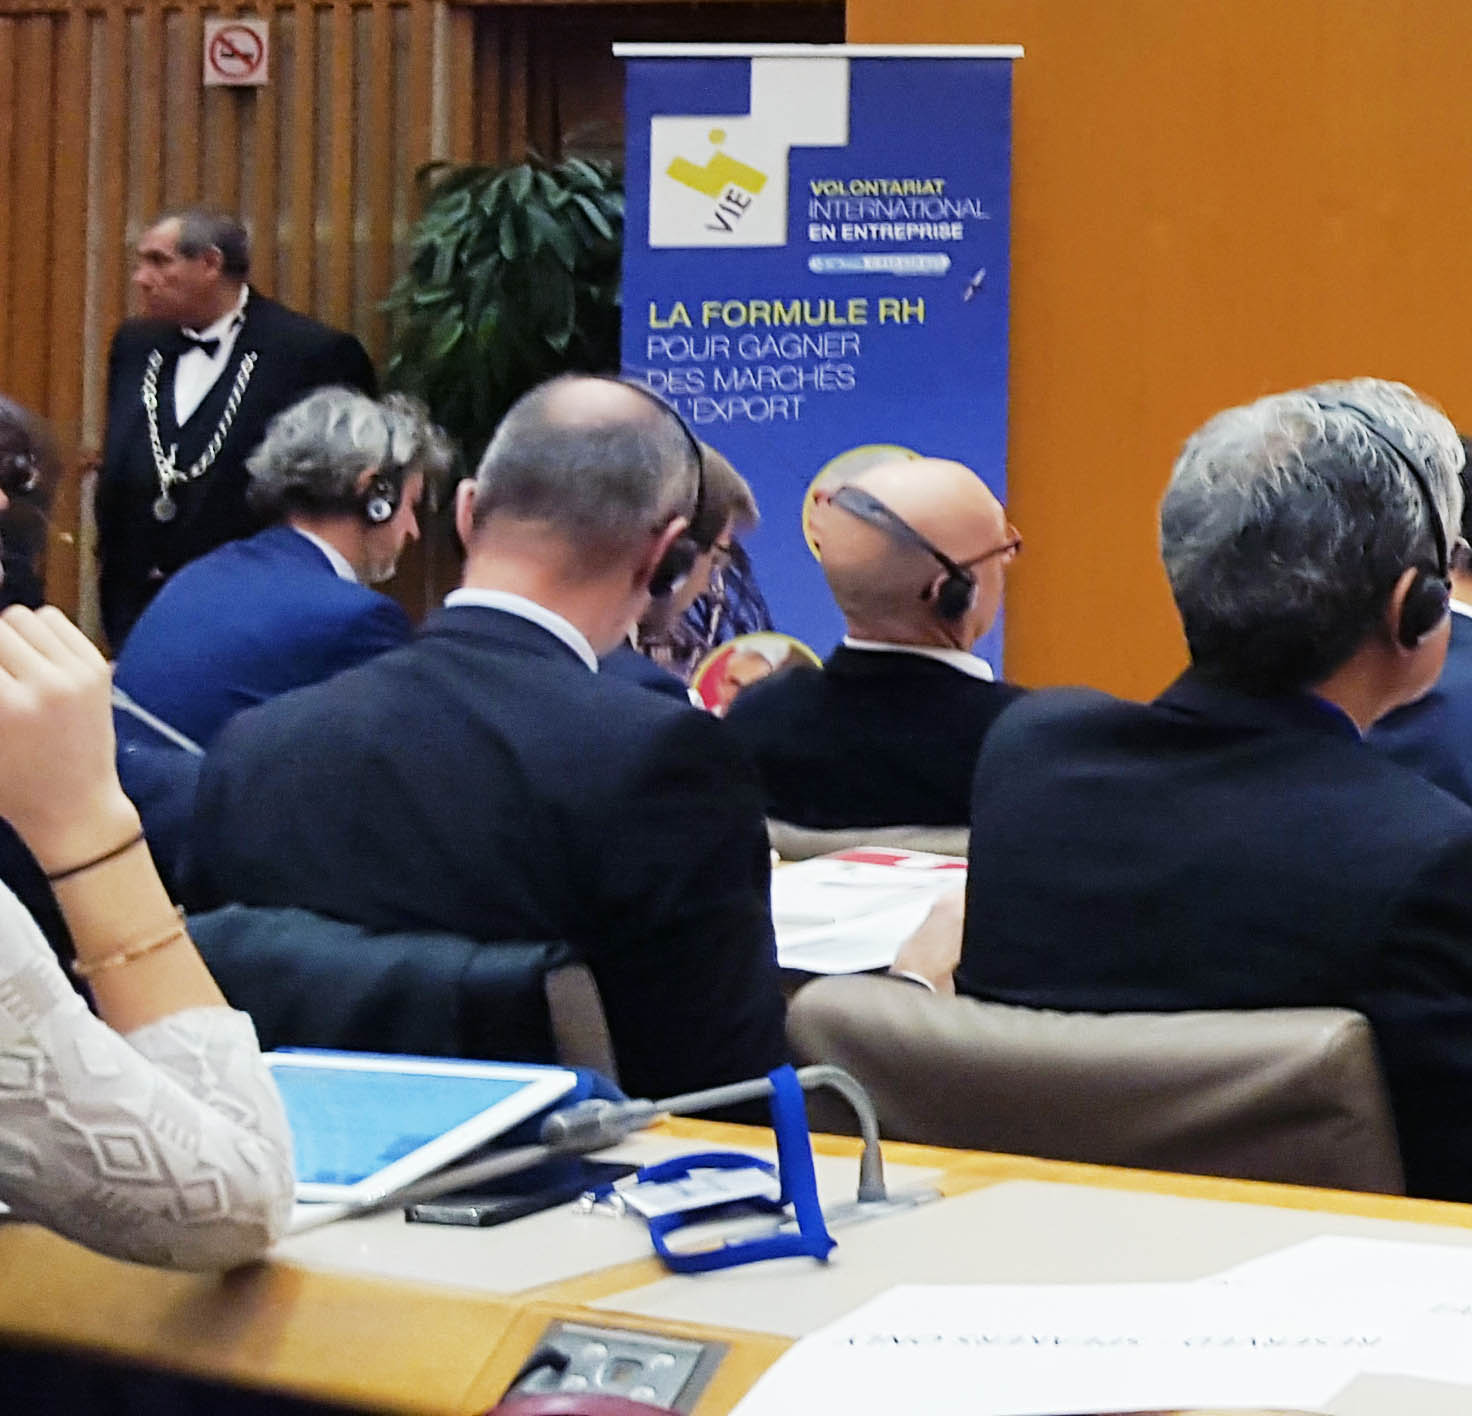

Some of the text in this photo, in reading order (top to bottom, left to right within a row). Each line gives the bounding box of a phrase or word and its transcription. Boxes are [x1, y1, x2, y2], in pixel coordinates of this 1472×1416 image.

[809, 178, 945, 197] VOLONTARIAT
[705, 188, 752, 234] VIE
[808, 197, 991, 221] INTERNATIONAL
[808, 221, 964, 242] EN ENTREPRISE
[649, 297, 925, 329] LA FORMULE RH
[647, 331, 861, 362] POUR GAGNER
[647, 360, 856, 394] DES MARCHÉS
